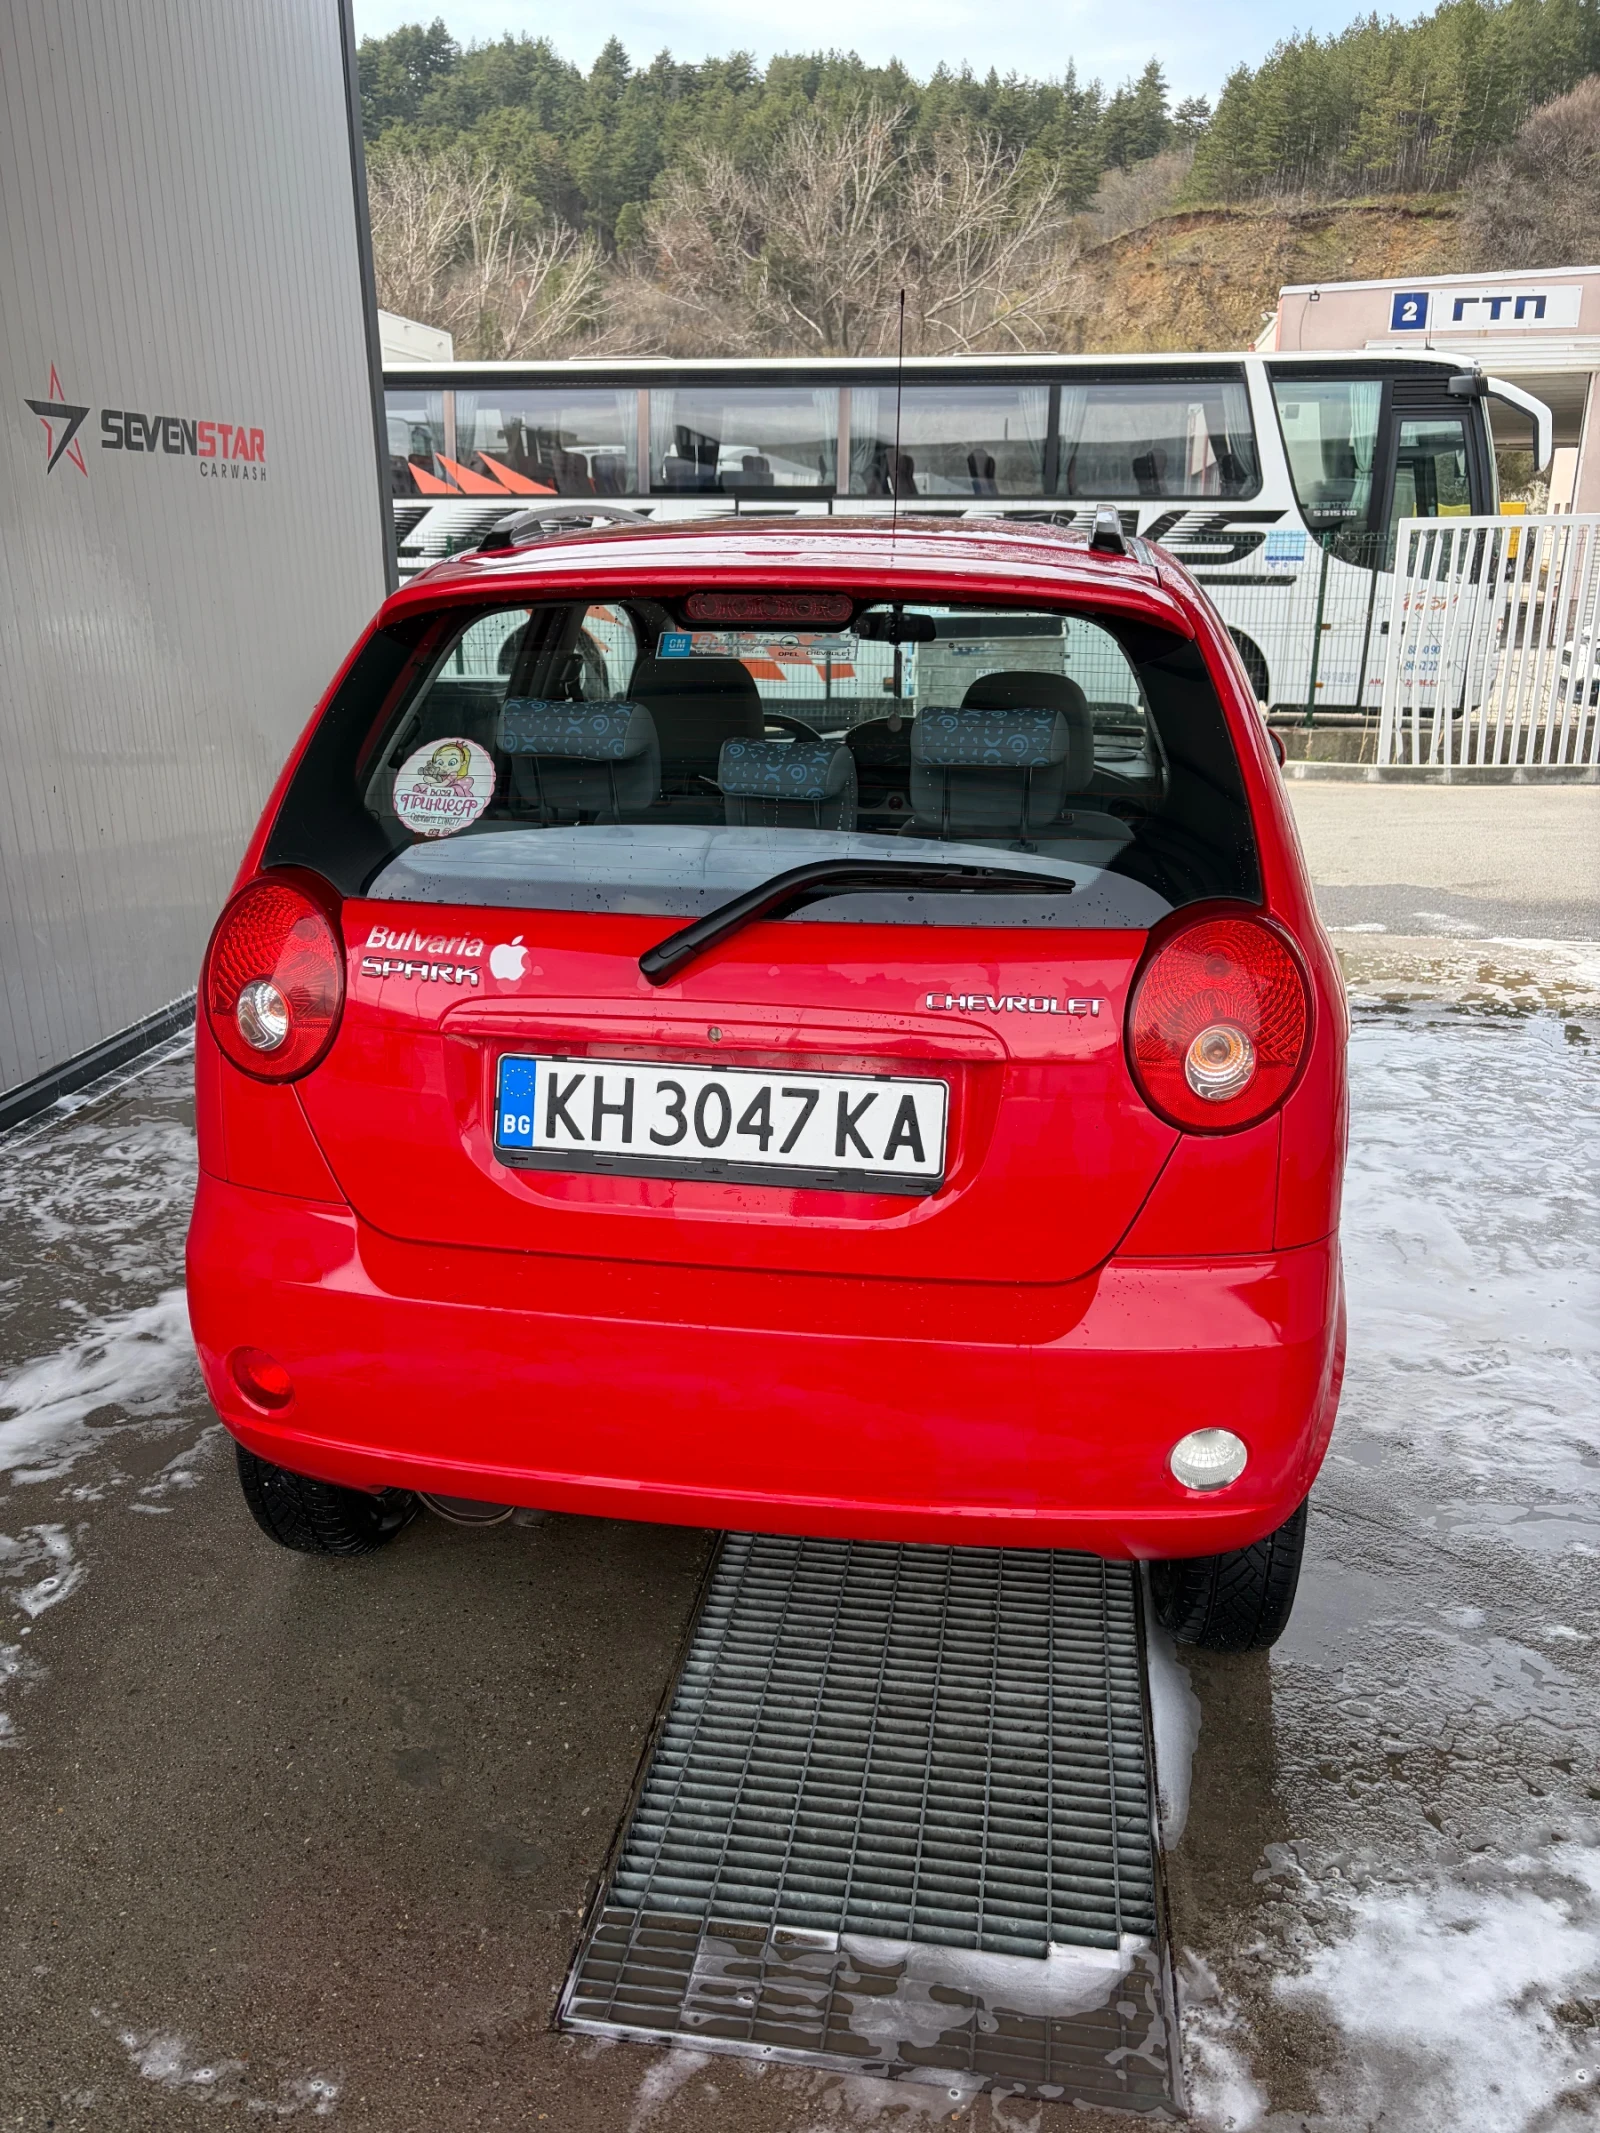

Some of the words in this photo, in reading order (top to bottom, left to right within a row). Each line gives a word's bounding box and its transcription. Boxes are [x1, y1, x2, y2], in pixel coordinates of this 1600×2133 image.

[1402, 301, 1418, 321] 2
[1452, 295, 1547, 321] ГТП
[101, 409, 265, 463] SEVENSTAR
[200, 462, 267, 481] CARWASH
[668, 638, 686, 649] GM
[365, 925, 484, 957] Bulvaria
[361, 956, 482, 986] SPARK
[926, 993, 1105, 1016] CHEVROLET
[503, 1114, 530, 1135] BG
[649, 1081, 820, 1154] 3047
